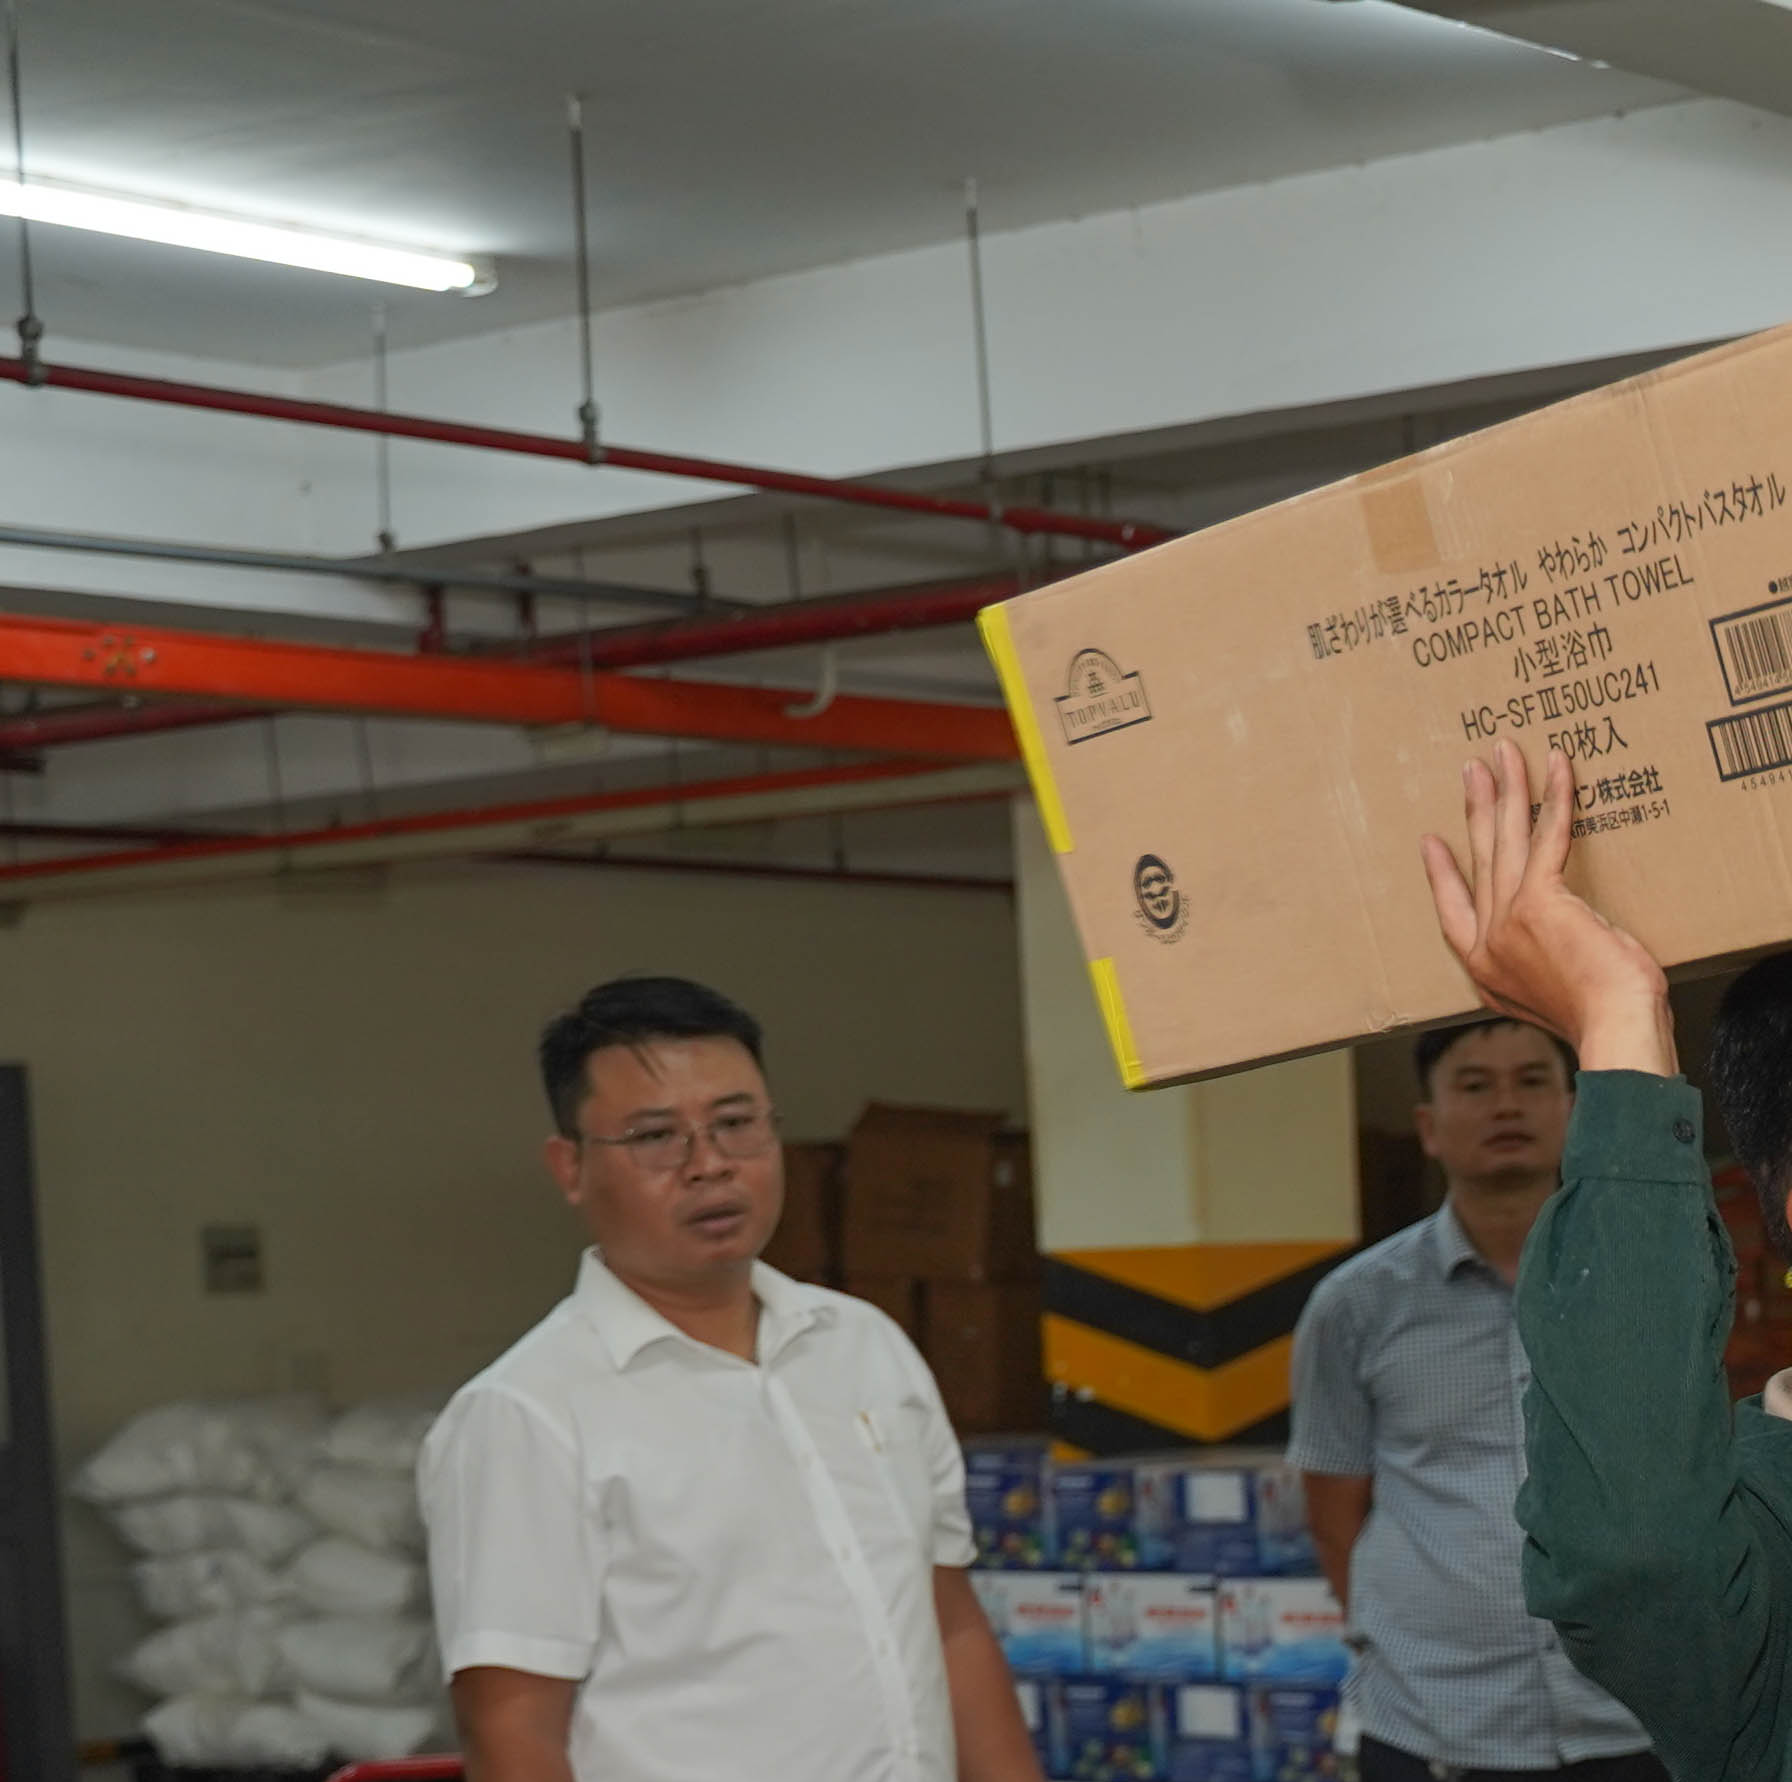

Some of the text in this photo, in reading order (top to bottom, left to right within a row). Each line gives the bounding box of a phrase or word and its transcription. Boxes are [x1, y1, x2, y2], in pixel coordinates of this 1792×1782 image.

[1538, 531, 1608, 586] やわらか
[1413, 554, 1694, 668] COMPACT BATH TOWEL
[1513, 621, 1613, 684] 小型浴巾
[1065, 690, 1142, 729] TOPVALU
